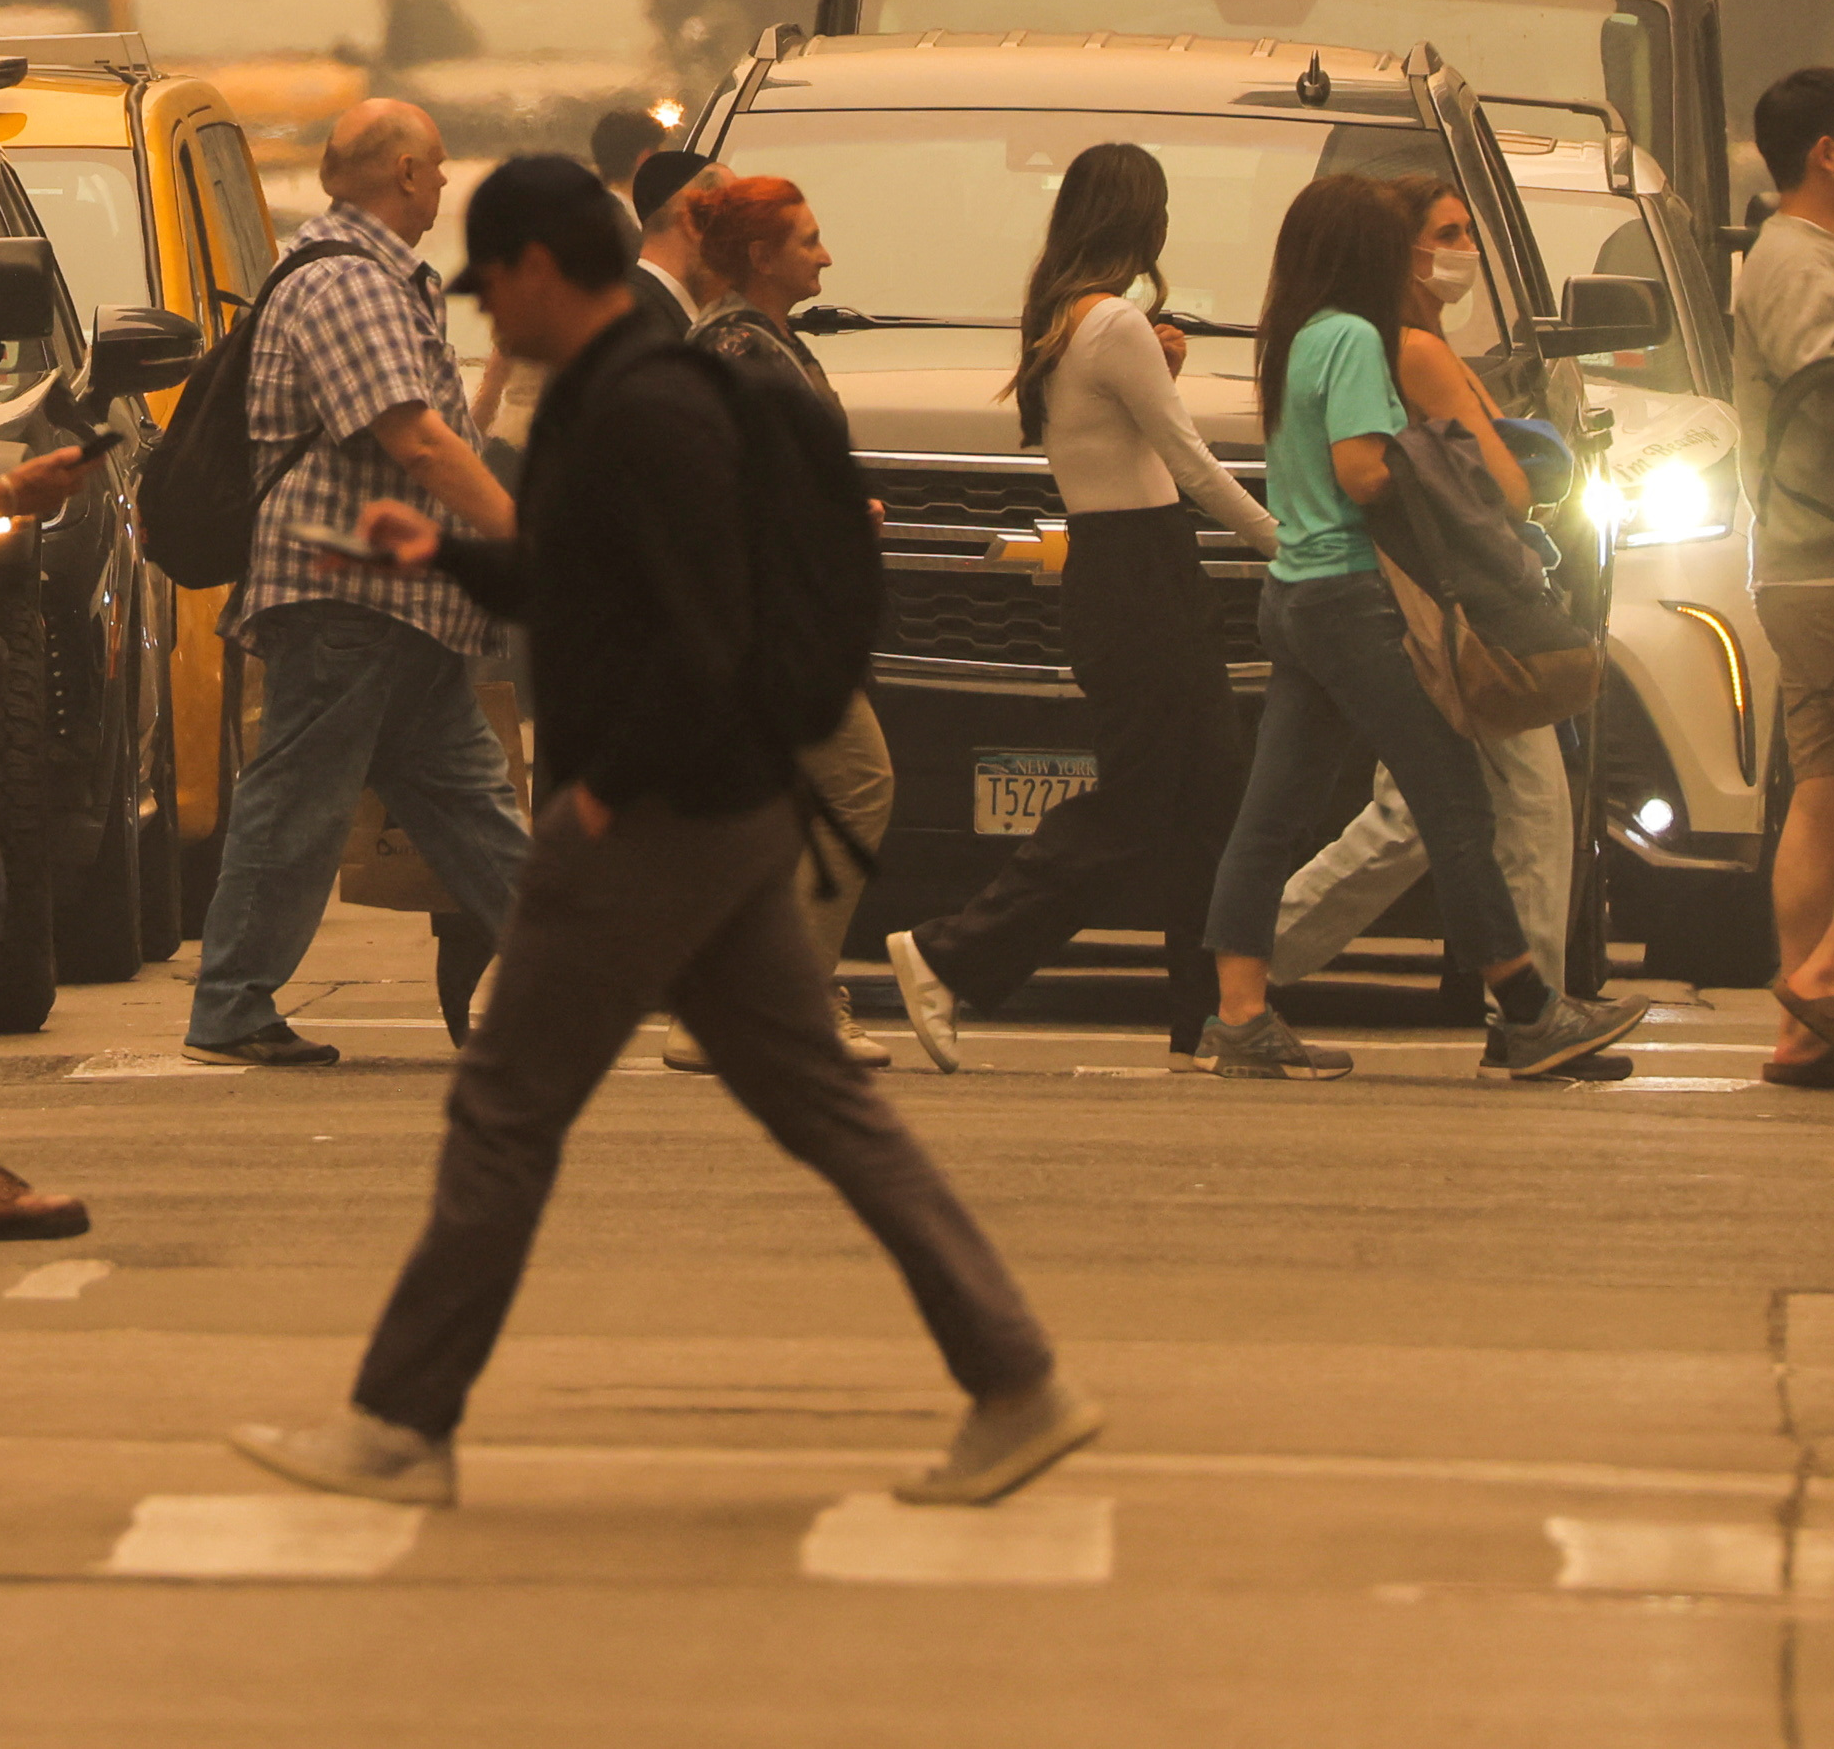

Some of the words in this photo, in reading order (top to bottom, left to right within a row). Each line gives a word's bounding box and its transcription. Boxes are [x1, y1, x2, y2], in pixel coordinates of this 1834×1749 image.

[1015, 759, 1051, 775] NEW
[1056, 760, 1095, 776] YORK
[988, 777, 1097, 817] T5227
